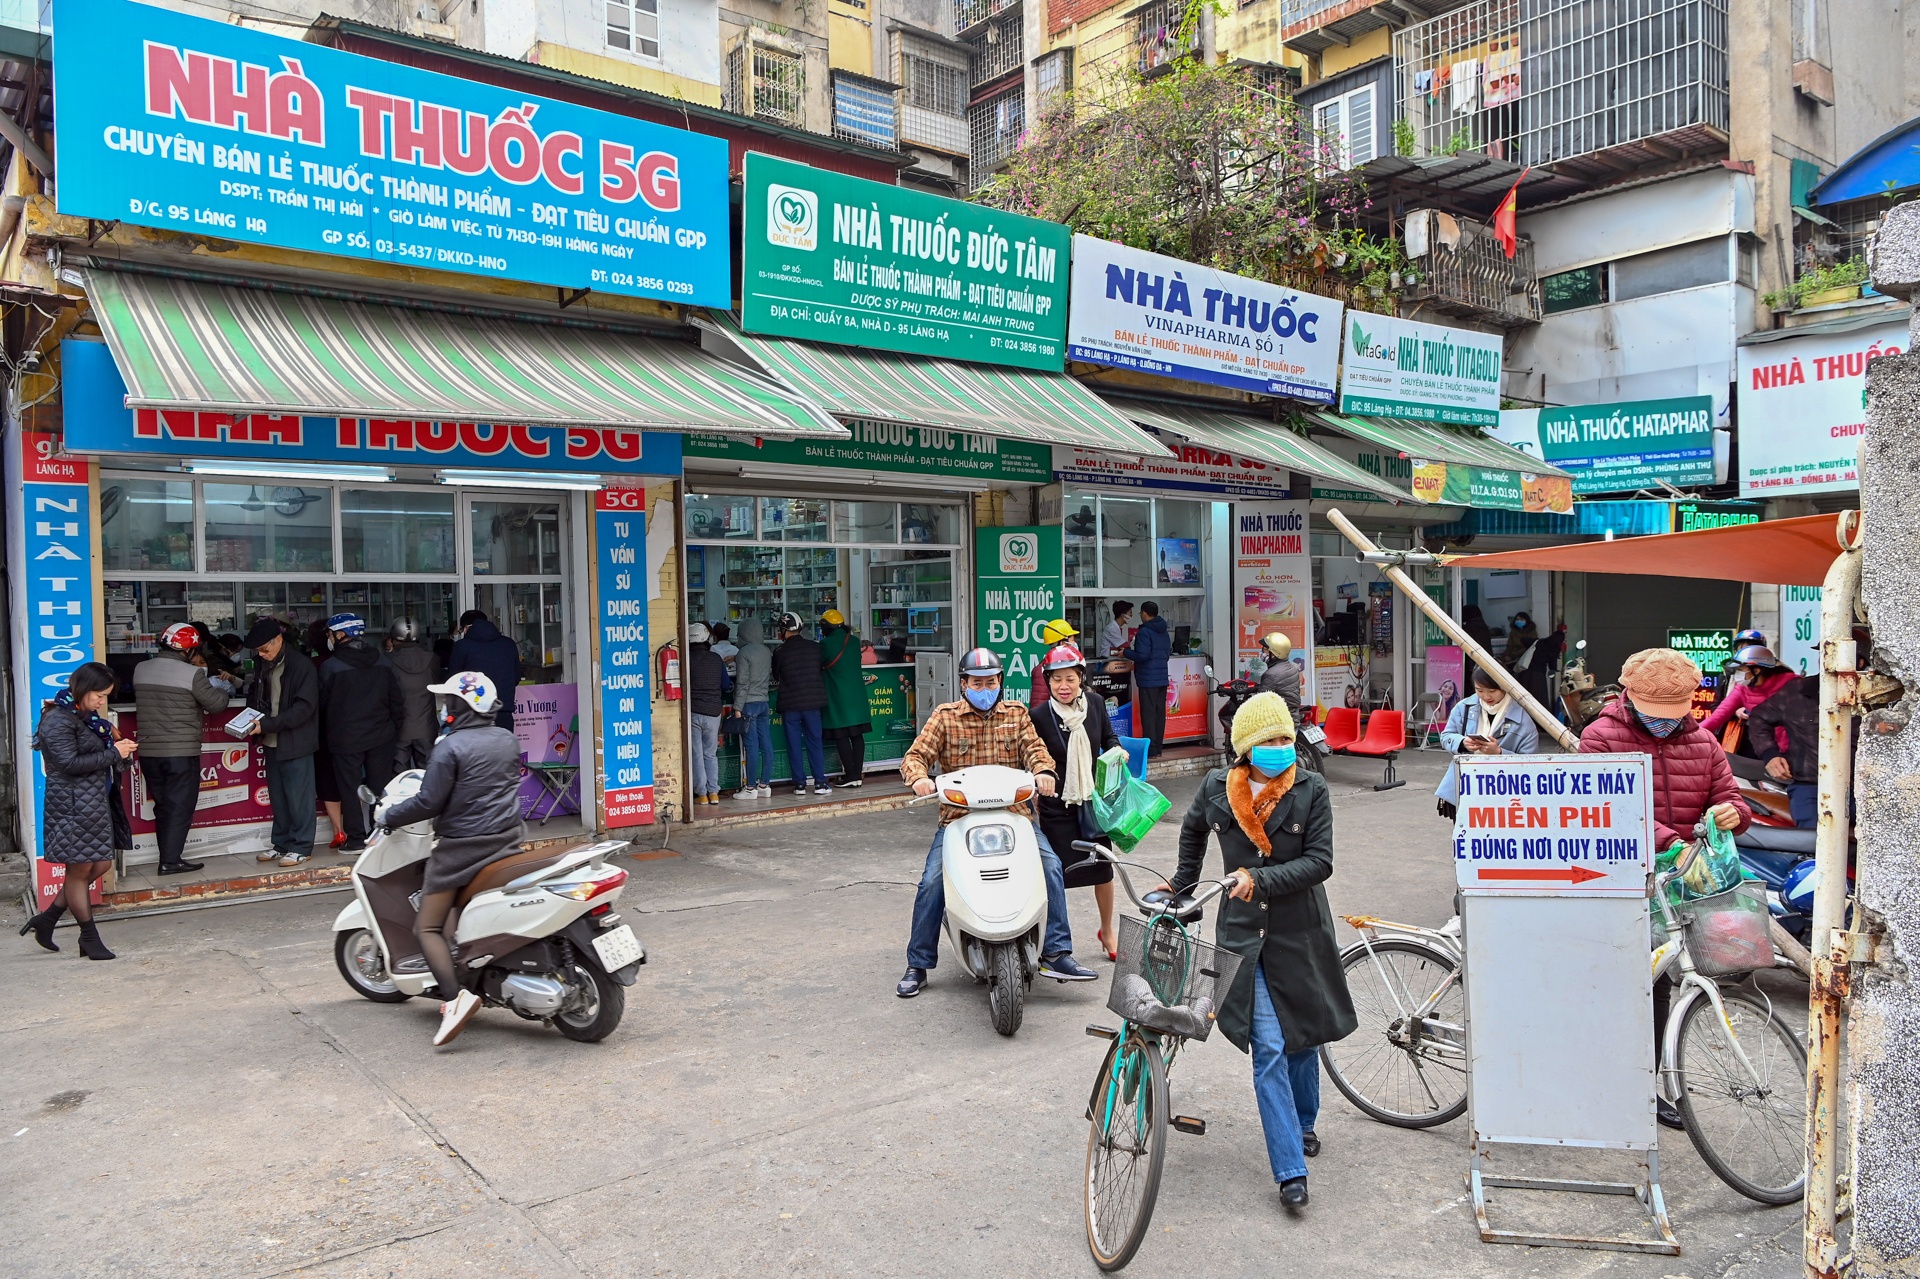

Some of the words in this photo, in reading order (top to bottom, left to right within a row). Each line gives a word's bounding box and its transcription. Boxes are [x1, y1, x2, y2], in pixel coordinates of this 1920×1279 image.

[143, 39, 326, 148] NHÀ
[345, 84, 584, 195] THUỐC
[599, 139, 681, 212] 5G
[104, 126, 204, 173] CHUYÊN
[213, 143, 260, 175] BÁN
[268, 151, 292, 180] LẺ
[300, 163, 374, 195] THUỐC
[381, 176, 448, 208] THÀNH
[454, 186, 511, 218] PHẨM
[532, 202, 567, 229] ĐẠT
[574, 210, 609, 234] TIÊU
[615, 216, 669, 244] CHUẨN
[675, 228, 706, 250] GPP
[129, 198, 163, 217] Đ/C:
[168, 204, 190, 221] 95
[194, 206, 236, 228] LÁNG
[246, 215, 267, 234] HẠ
[833, 202, 882, 250] NHÀ
[890, 212, 960, 265] THUỐC
[967, 225, 1008, 274] ĐỨC
[1015, 237, 1056, 284] TÂM
[591, 268, 609, 284] ĐT:
[611, 272, 633, 286] 024
[636, 275, 663, 291] 3856
[667, 280, 693, 295] 0293
[833, 256, 854, 283] BÁN
[856, 254, 868, 284] LẺ
[871, 262, 900, 291] THUỐC
[903, 268, 932, 295] THÀNH
[935, 270, 961, 301] PHẨM
[969, 282, 985, 308] ĐẠT
[987, 285, 1006, 307] TIÊU
[1006, 285, 1034, 313] CHUẨN
[1036, 295, 1051, 316] GPP
[851, 292, 881, 310] DƯỢC
[884, 297, 899, 310] SỸ
[900, 300, 922, 316] PHỤ
[924, 302, 960, 321] TRÁCH:
[963, 311, 980, 323] MAI
[982, 312, 1002, 326] ANH
[1004, 316, 1035, 331] TRUNG
[1105, 263, 1192, 317] NHÀ
[1203, 287, 1319, 343] THUỐC
[770, 305, 789, 319] ĐỊA
[791, 306, 811, 321] CHỈ:
[814, 310, 842, 326] QUẦY
[844, 316, 859, 329] 8A,
[861, 316, 881, 331] NHÀ
[884, 320, 890, 331] D
[898, 323, 908, 335] 95
[910, 323, 935, 339] LÁNG
[937, 328, 949, 342] HẠ
[1145, 314, 1250, 348] VINAPHARMA
[1255, 334, 1273, 353] SỐ
[1279, 343, 1284, 355] 1
[990, 336, 1003, 348] ĐT:
[1004, 339, 1018, 350] 024
[1020, 341, 1037, 353] 3856
[1038, 344, 1055, 356] 1980
[1115, 330, 1135, 344] BÁN
[1137, 333, 1148, 346] LẺ
[1150, 337, 1180, 352] THUỐC
[1182, 342, 1211, 358] THÀNH
[1213, 346, 1238, 362] PHẨM
[1245, 356, 1260, 369] ĐẠT
[1262, 357, 1289, 373] CHUẨN
[1290, 364, 1305, 375] GPP
[1356, 341, 1396, 361] VitaGold
[1398, 332, 1419, 372] NHÀ
[1422, 332, 1453, 377] THUỐC
[1457, 346, 1499, 382] VITAGOLD
[1752, 357, 1805, 390] NHÀ
[1351, 401, 1362, 411] Đ/C:
[1364, 403, 1370, 412] 95
[1371, 404, 1383, 415] Láng
[1385, 405, 1392, 416] Hạ
[1395, 407, 1403, 415] ĐT:
[1546, 415, 1579, 444] NHÀ
[1581, 410, 1630, 441] THUỐC
[1633, 410, 1710, 438] HATAPHAR
[806, 446, 823, 456] BÁN
[825, 446, 835, 457] LẺ
[837, 447, 864, 460] THUỐC
[866, 451, 891, 462] THÀNH
[893, 451, 915, 464] PHẨM
[921, 457, 935, 467] ĐẠT
[937, 457, 953, 467] TIÊU
[954, 457, 979, 468] CHUẨN
[980, 462, 994, 470] GPP
[36, 464, 59, 475] LÁNG
[62, 464, 75, 478] HẠ
[1587, 471, 1592, 480] lý
[1594, 468, 1617, 480] chuyên
[1618, 467, 1632, 476] môn
[1633, 464, 1654, 476] DSĐH:
[1655, 462, 1679, 472] PHÙNG
[1680, 462, 1695, 470] ANH
[1697, 461, 1711, 469] THƯ
[1761, 477, 1781, 487] LÁNG
[1801, 473, 1823, 483] ĐỐNG
[1826, 473, 1837, 481] ĐA
[1845, 471, 1856, 480] HÀ
[606, 492, 638, 507] 5G
[34, 498, 82, 560] NHÀ
[614, 522, 630, 538] TƯ
[1241, 512, 1263, 532] NHÀ
[1267, 509, 1302, 531] THUỐC
[610, 544, 634, 564] VẤN
[1241, 535, 1302, 555] VINAPHARMA
[616, 570, 631, 591] SỬ
[985, 587, 1011, 610] NHÀ
[1014, 584, 1053, 610] THUỐC
[607, 600, 640, 618] DỤNG
[605, 622, 644, 642] THUỐC
[1796, 610, 1812, 641] SỐ
[1671, 634, 1693, 648] NHÀ
[1693, 632, 1729, 648] THUỐC
[612, 647, 639, 666] CHẤT
[1800, 657, 1807, 677] 2
[608, 674, 644, 692] LƯỢNG
[874, 687, 892, 695] GIẢM
[527, 700, 557, 714] Vương
[620, 698, 634, 712] AN
[613, 720, 642, 736] TOÀN
[617, 744, 640, 762] HIỆU
[618, 762, 640, 785] QUẢ
[1476, 770, 1531, 795] TRÔNG
[1537, 768, 1567, 795] GIỮ
[1571, 773, 1591, 795] XE
[1597, 769, 1636, 795] MÁY
[616, 793, 628, 803] Điện
[630, 792, 644, 801] thoại:
[609, 807, 620, 816] 024
[621, 805, 635, 814] 3856
[637, 804, 651, 813] 0293
[1468, 798, 1548, 828] MIỄN
[1560, 802, 1612, 828] PHÍ
[1471, 834, 1517, 860] ĐÚNG
[1524, 838, 1552, 860] NƠI
[1558, 838, 1590, 863] QUY
[1595, 838, 1638, 865] ĐỊNH
[510, 898, 545, 908] LEAD
